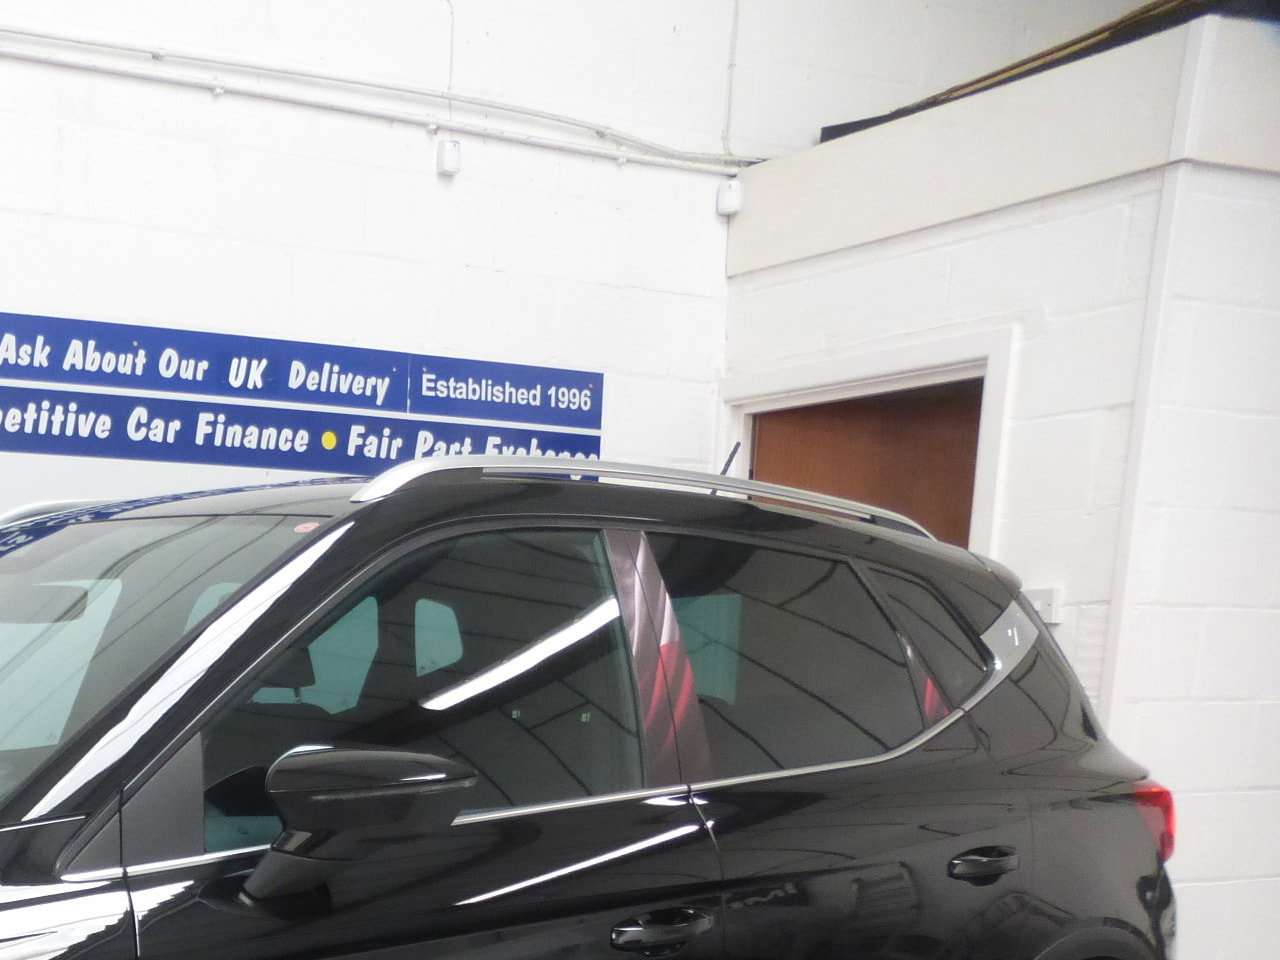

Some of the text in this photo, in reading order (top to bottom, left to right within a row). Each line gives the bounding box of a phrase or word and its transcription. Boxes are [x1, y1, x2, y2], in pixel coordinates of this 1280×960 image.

[63, 338, 147, 376] About
[158, 348, 209, 382] Our
[228, 357, 269, 389] UK
[287, 360, 391, 405] Delivery
[421, 373, 592, 411] Established 1996
[126, 407, 182, 444] Car
[195, 413, 309, 453] Finance
[346, 426, 404, 460] Fair
